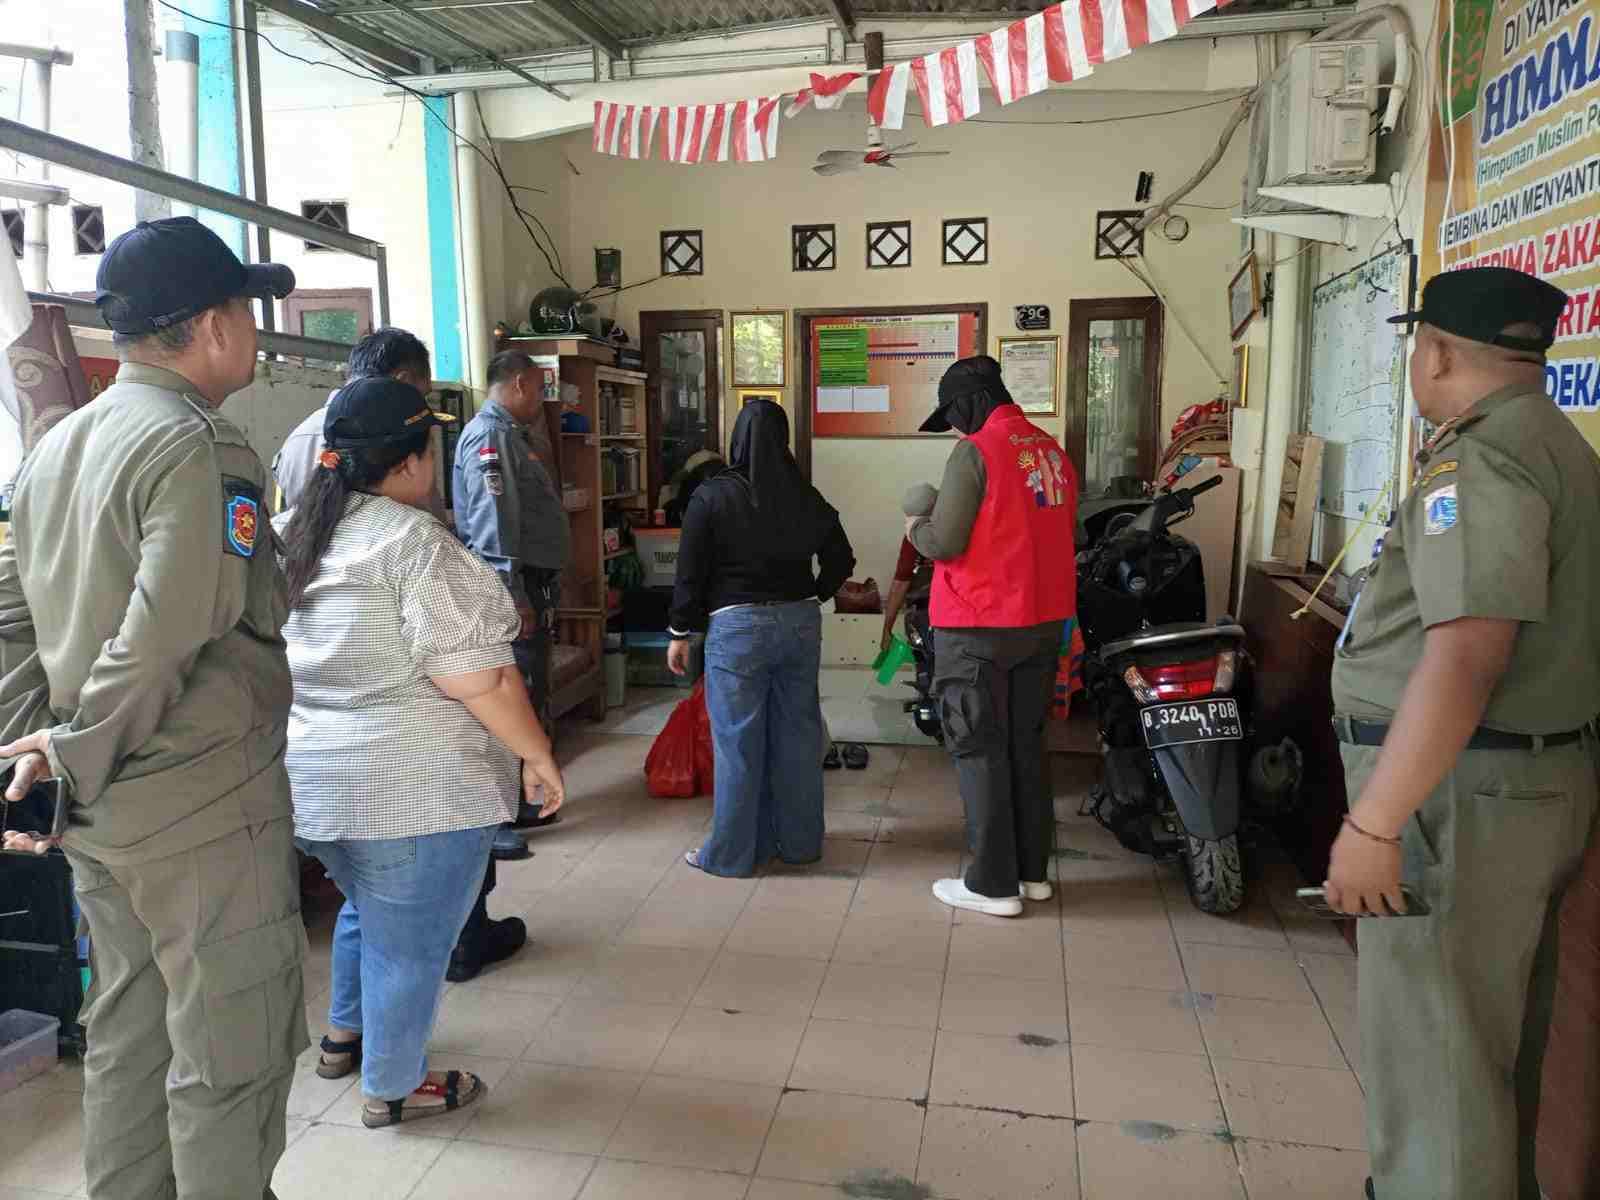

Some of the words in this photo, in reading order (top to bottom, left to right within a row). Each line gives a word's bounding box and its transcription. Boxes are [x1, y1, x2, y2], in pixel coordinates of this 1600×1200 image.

[1504, 14, 1521, 56] DI
[1526, 0, 1579, 38] YAYA
[1537, 113, 1583, 156] Muslim
[1491, 194, 1520, 228] DAN
[1144, 711, 1153, 728] B
[1159, 705, 1200, 724] 3240
